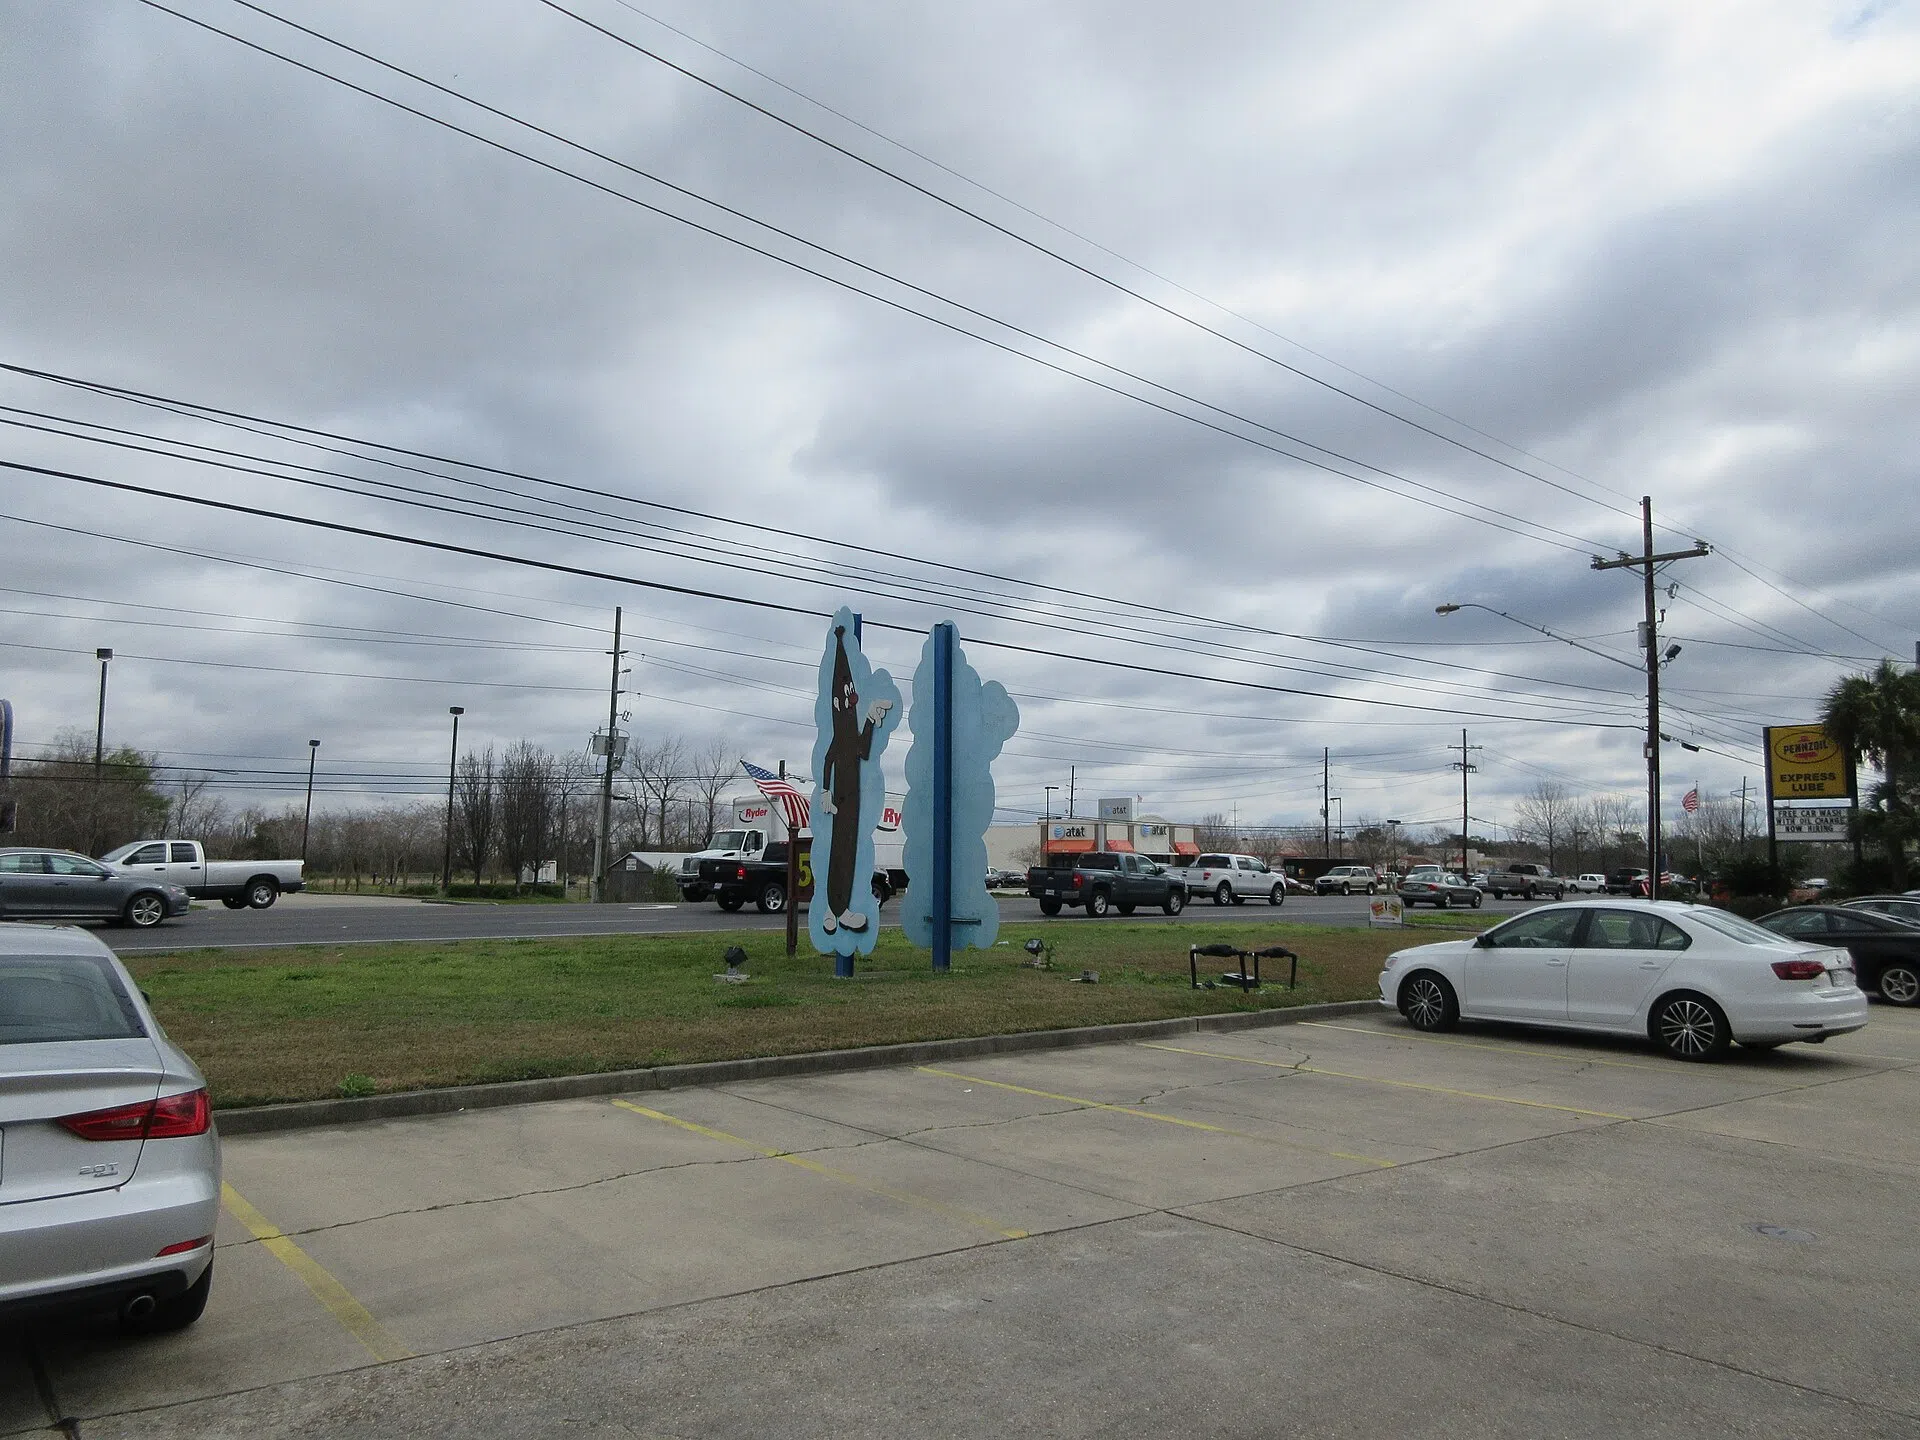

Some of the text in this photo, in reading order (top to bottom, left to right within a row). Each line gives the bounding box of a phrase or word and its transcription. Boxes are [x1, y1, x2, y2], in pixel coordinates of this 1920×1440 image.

[1783, 740, 1829, 755] PENNZOIL
[1780, 772, 1837, 783] EXPRESS
[1792, 782, 1825, 792] LUBE
[745, 808, 768, 820] Ryder
[1112, 806, 1127, 815] at&t
[1778, 810, 1798, 818] FREE
[1819, 809, 1842, 817] WASH
[1776, 817, 1796, 825] WITH
[1799, 817, 1812, 825] OIL
[1065, 826, 1085, 837] at&t
[1151, 825, 1167, 836] at&t
[1785, 825, 1834, 833] NOW HIRING
